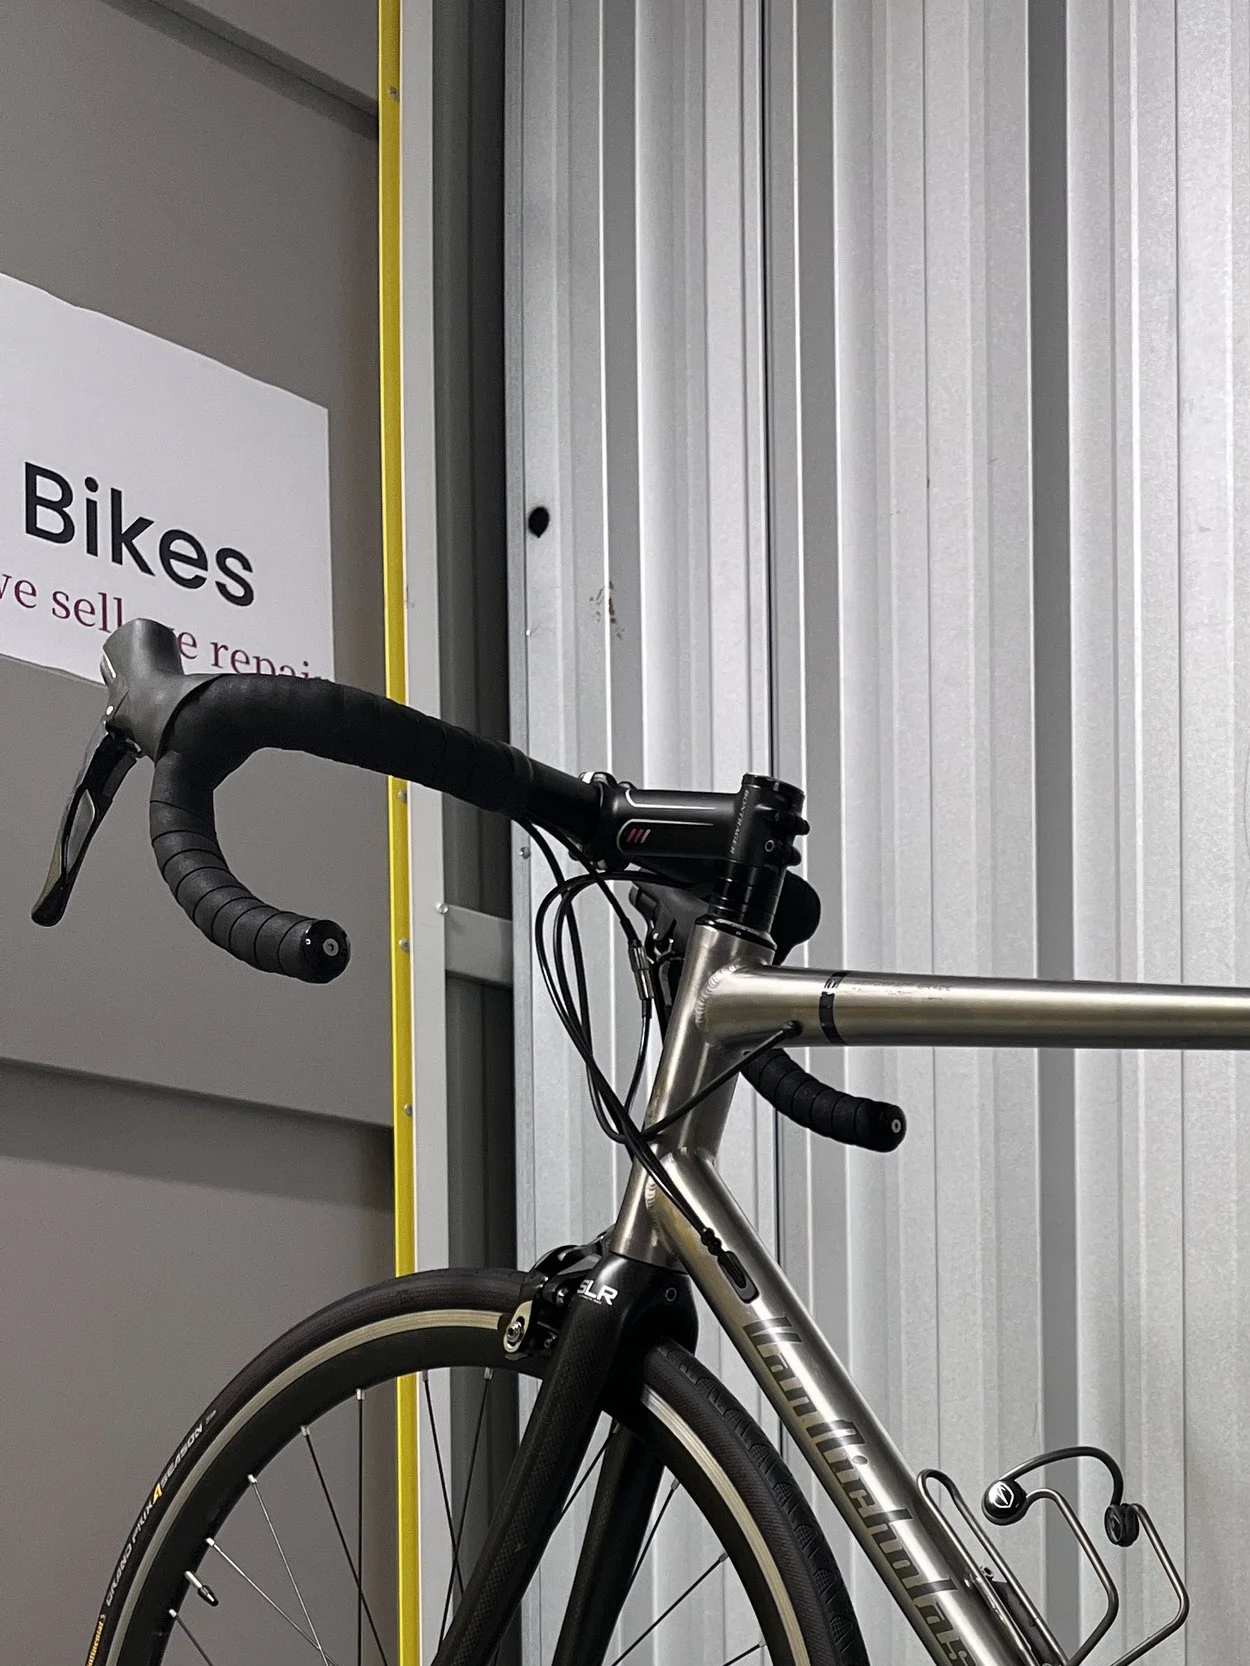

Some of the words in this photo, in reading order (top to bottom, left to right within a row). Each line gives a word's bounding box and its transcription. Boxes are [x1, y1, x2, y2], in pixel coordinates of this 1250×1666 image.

[24, 461, 255, 608] Bikes
[51, 590, 125, 634] sell
[576, 1278, 619, 1306] SLR
[105, 1542, 133, 1607] GRAND
[131, 1499, 153, 1544] PRIX
[160, 1423, 204, 1488] SEASON
